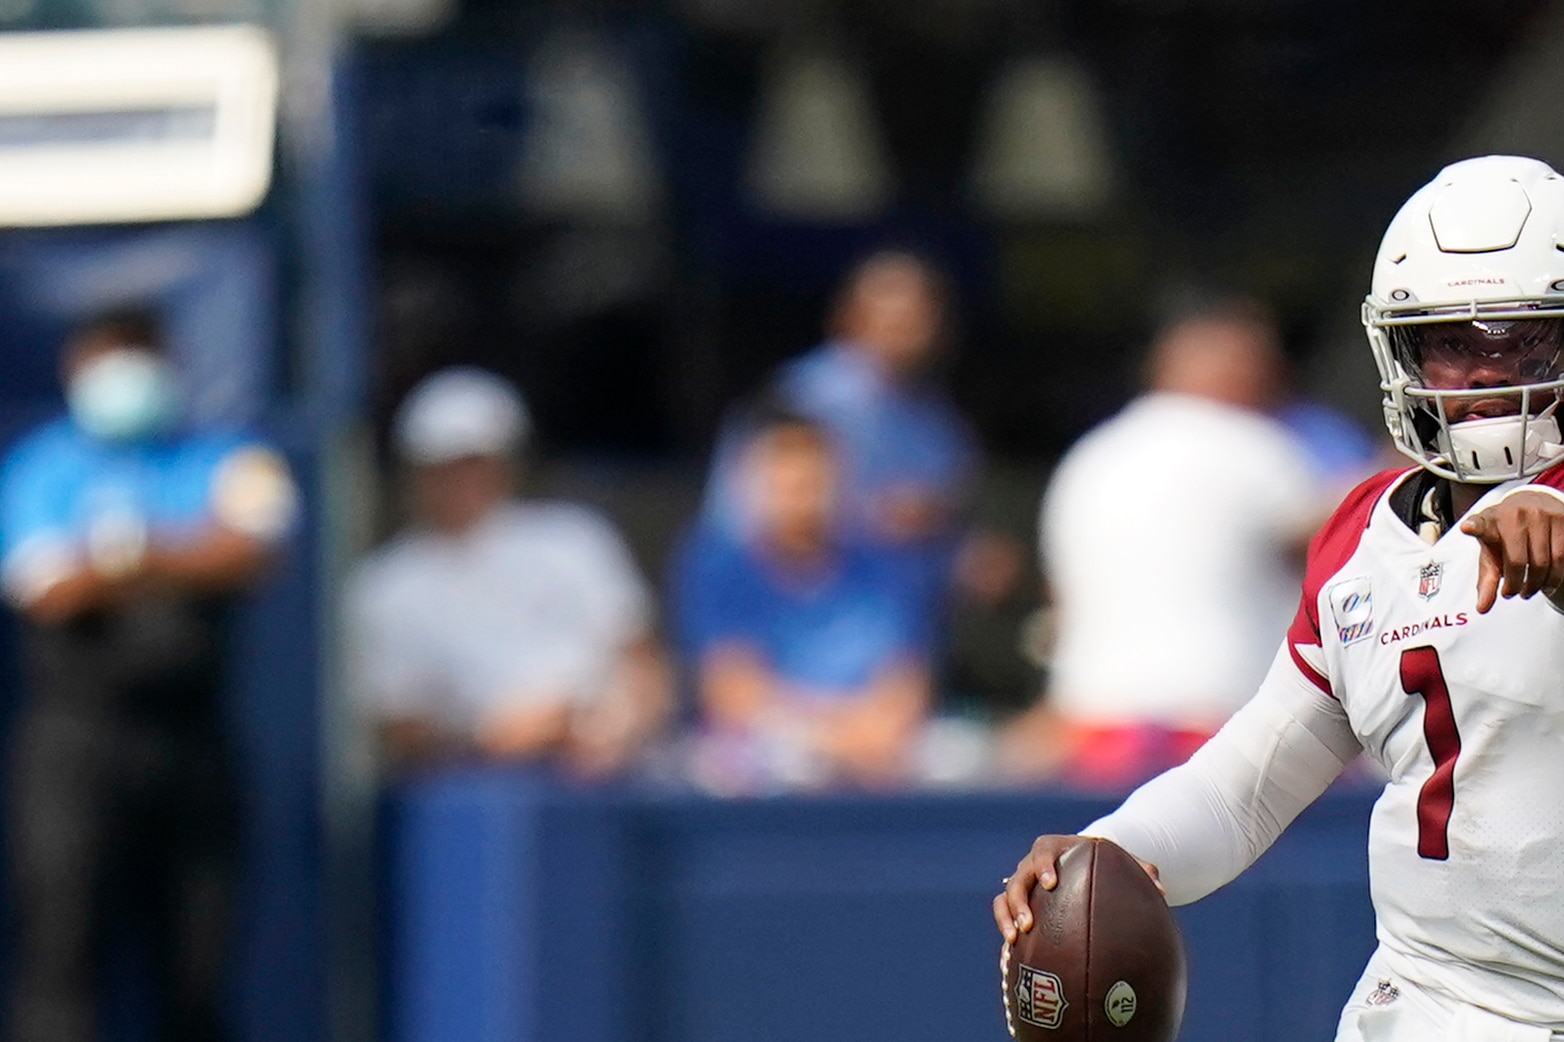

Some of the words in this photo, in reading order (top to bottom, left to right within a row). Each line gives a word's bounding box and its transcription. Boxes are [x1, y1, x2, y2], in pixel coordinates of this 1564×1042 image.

[1419, 577, 1435, 593] NFL
[1380, 612, 1469, 646] CARDINALS
[1400, 645, 1461, 860] 1
[1034, 979, 1058, 1022] NFL
[1120, 996, 1134, 1014] 112
